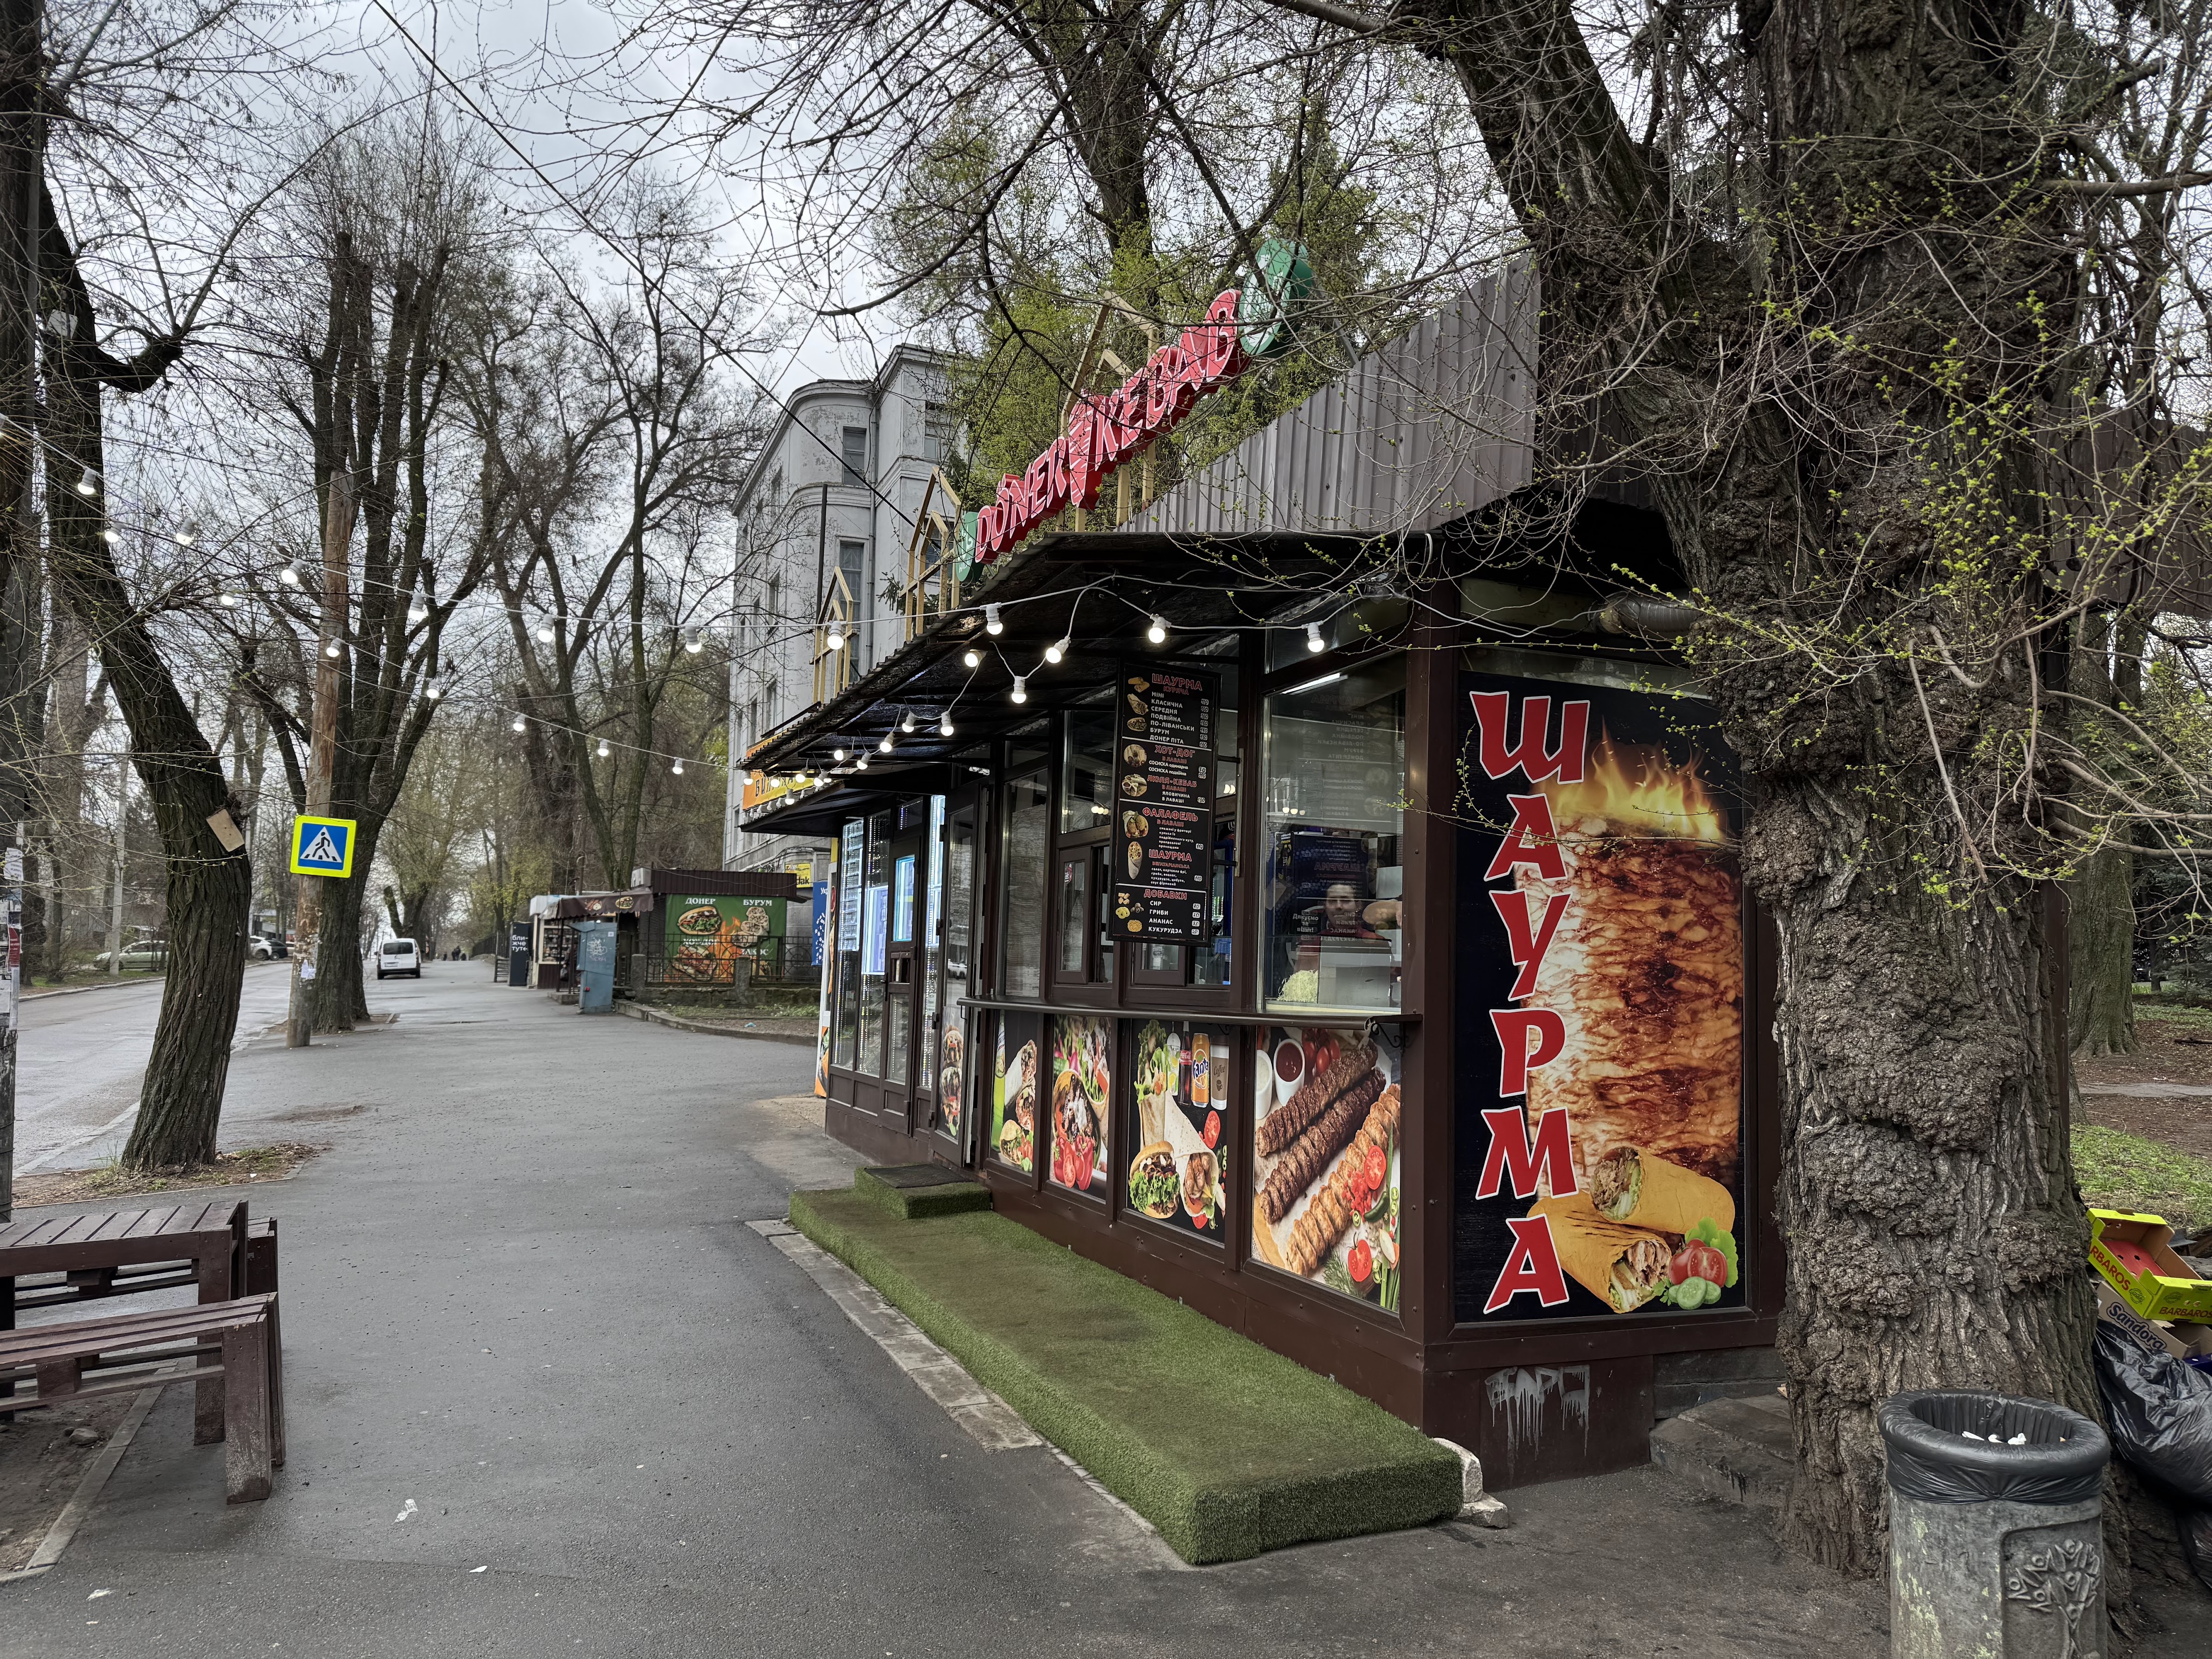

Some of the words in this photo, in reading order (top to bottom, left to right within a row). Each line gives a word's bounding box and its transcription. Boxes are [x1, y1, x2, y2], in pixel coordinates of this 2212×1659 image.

[1094, 288, 1242, 471] KEBAB
[1152, 673, 1202, 691] ШАУРМА
[1164, 686, 1189, 695] КУРЯЧА
[1152, 699, 1182, 708] КЛАСИЧНА
[1151, 706, 1177, 714] СЕРЕДНЯ
[1151, 713, 1181, 722] ПОДВІЙНА
[1150, 720, 1194, 731] ПО-ЛІВАНСЬКИ
[1155, 745, 1195, 758] ХОТ-ДОГ
[1147, 775, 1197, 788] ЛЮЛЯ-КЕБАБ
[1142, 807, 1198, 822] ФАЛАФЕЛЬ
[1149, 849, 1192, 862] ШАУРМА
[796, 877, 809, 885] dak
[1144, 889, 1187, 900] ДОБАВКИ
[1470, 691, 1590, 1314] ШАУРМА
[1214, 1065, 1225, 1077] Coffee
[2089, 1243, 2131, 1291] RBAROS
[2159, 1306, 2212, 1318] BARBAROS
[2107, 1303, 2166, 1350] Sandora
